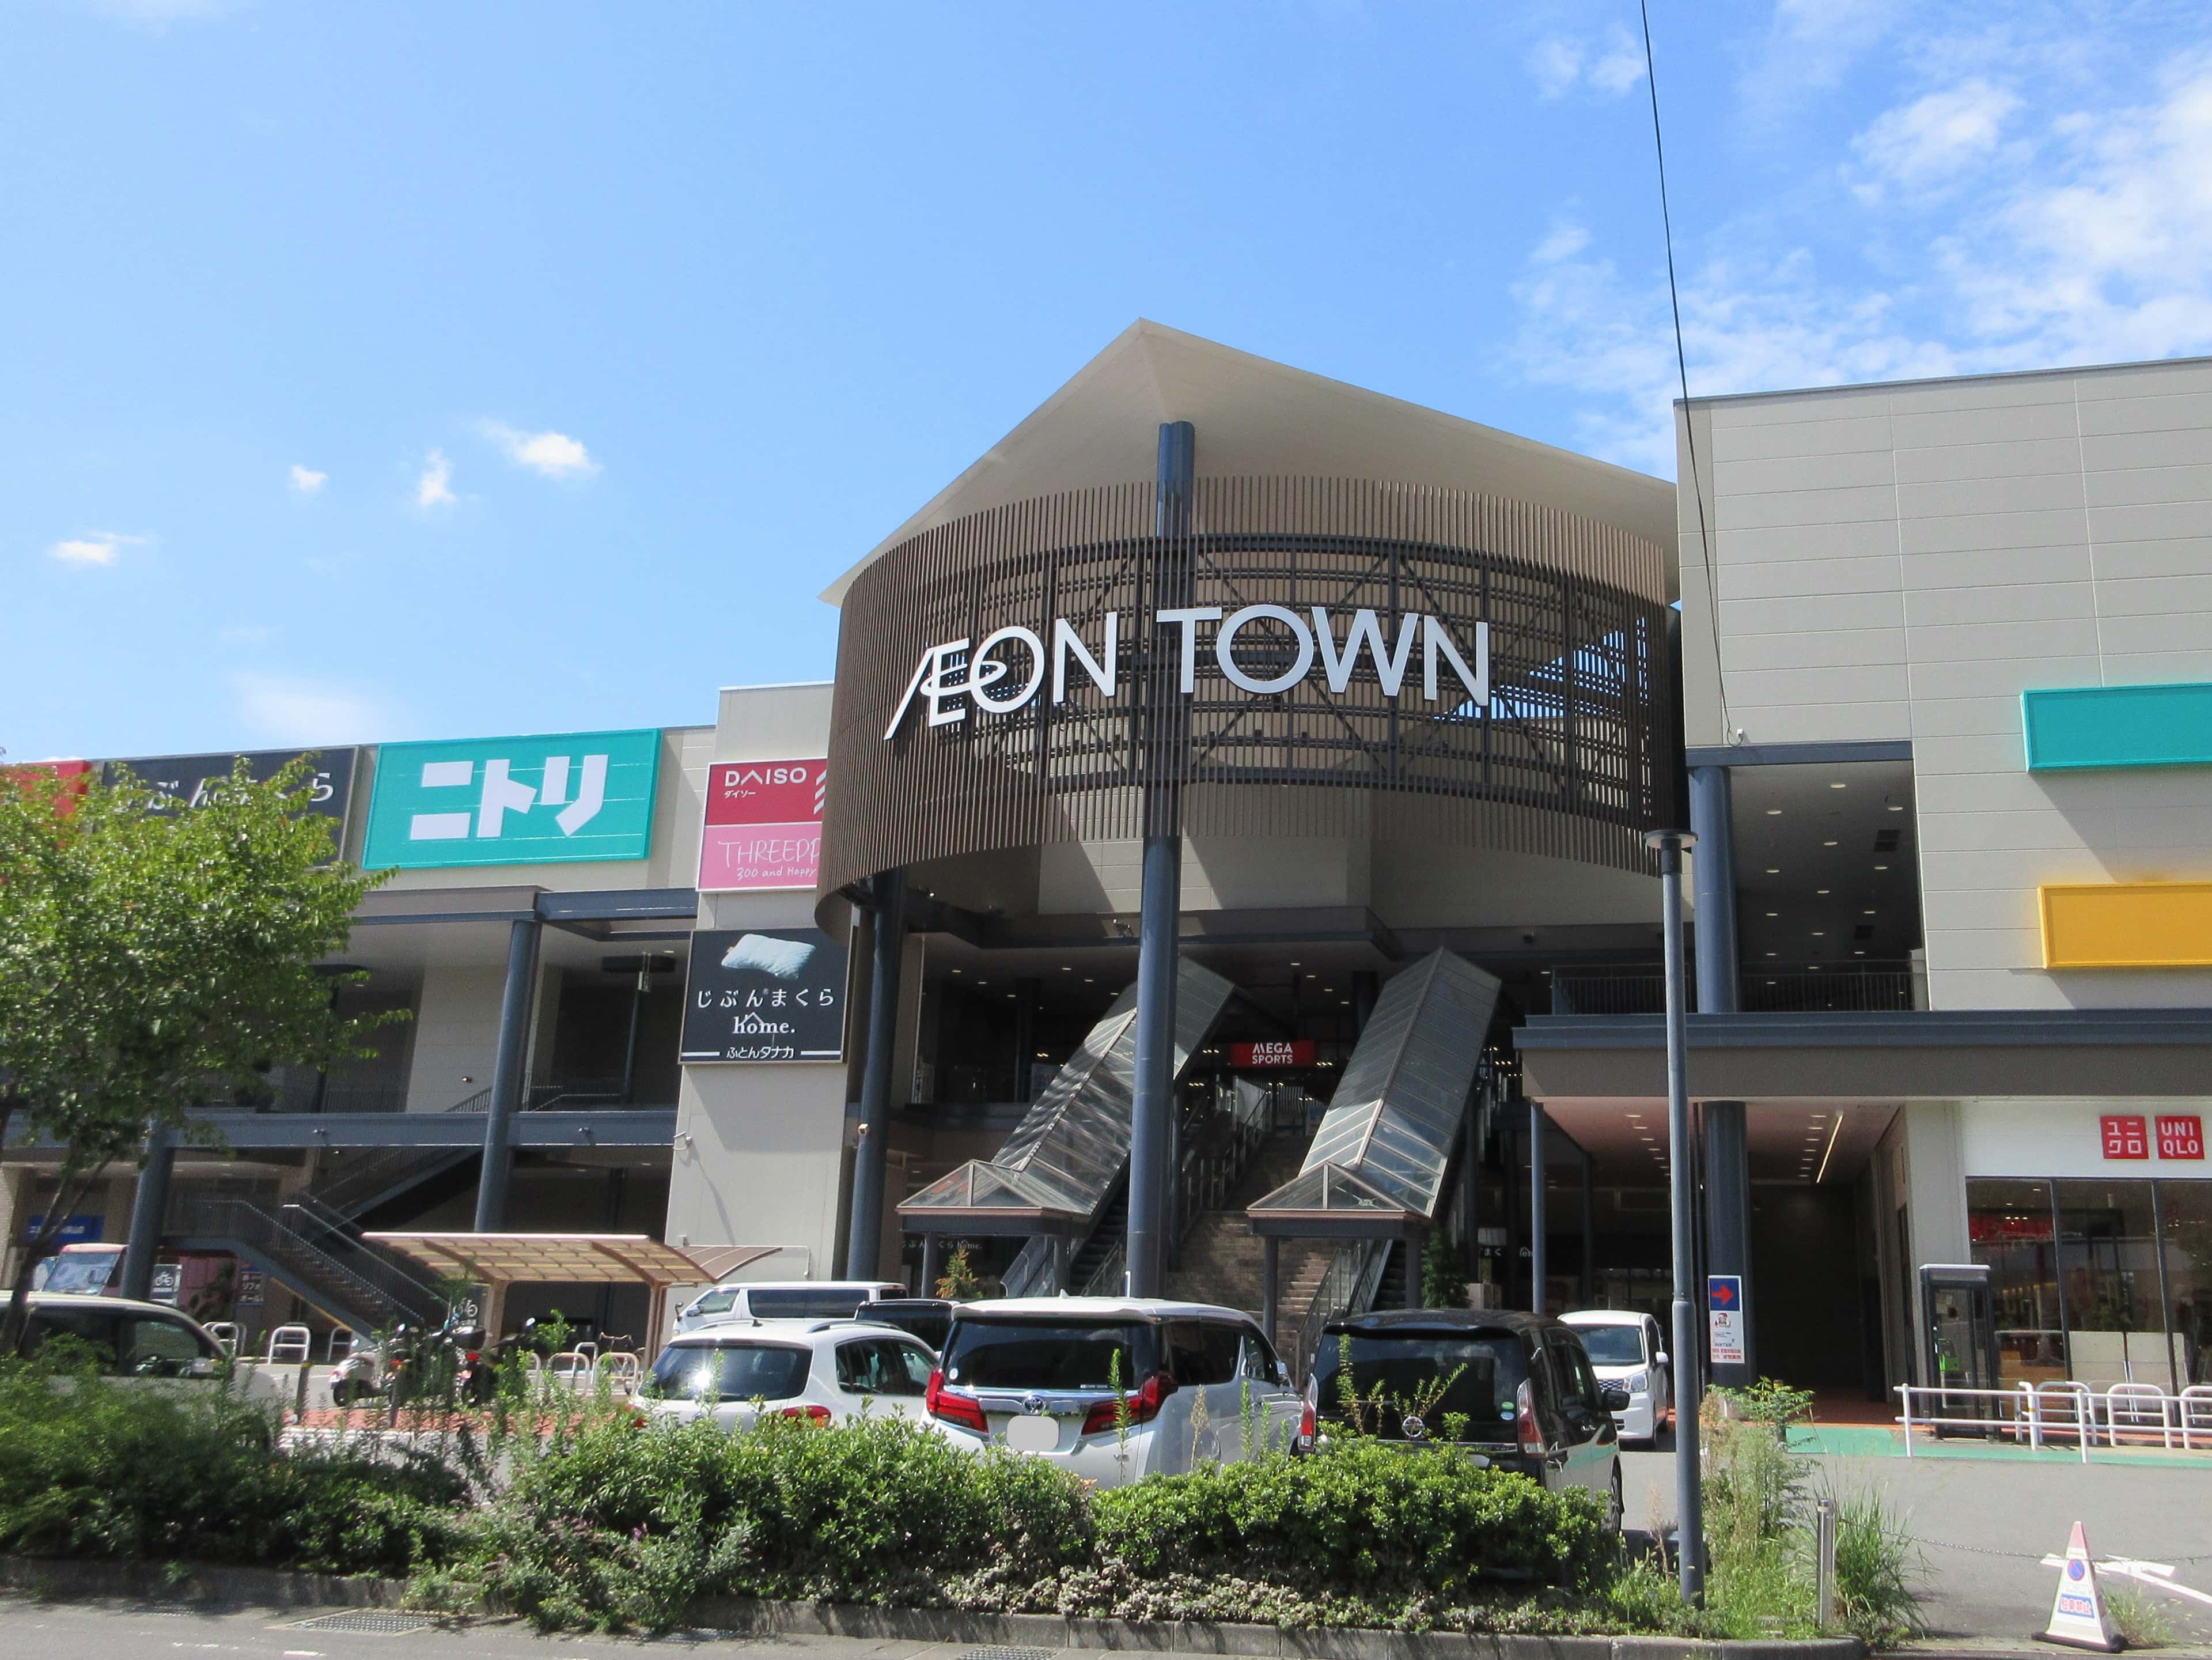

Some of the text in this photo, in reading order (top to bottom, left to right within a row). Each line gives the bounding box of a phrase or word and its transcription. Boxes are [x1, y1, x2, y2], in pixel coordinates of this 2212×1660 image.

[1156, 603, 1489, 706] TOWN
[724, 767, 807, 787] DAISO
[410, 754, 609, 841] ニトリ
[724, 789, 756, 799] ダイソー
[737, 866, 816, 881] 300 and Happy
[726, 1046, 794, 1059] ふとんタナカ
[1252, 1042, 1293, 1054] MEGA
[1252, 1054, 1293, 1064] SPORTS
[2107, 1121, 2141, 1136] ユニ
[2161, 1122, 2194, 1136] UNI
[2108, 1140, 2142, 1154] クロ
[2162, 1140, 2198, 1156] QLO
